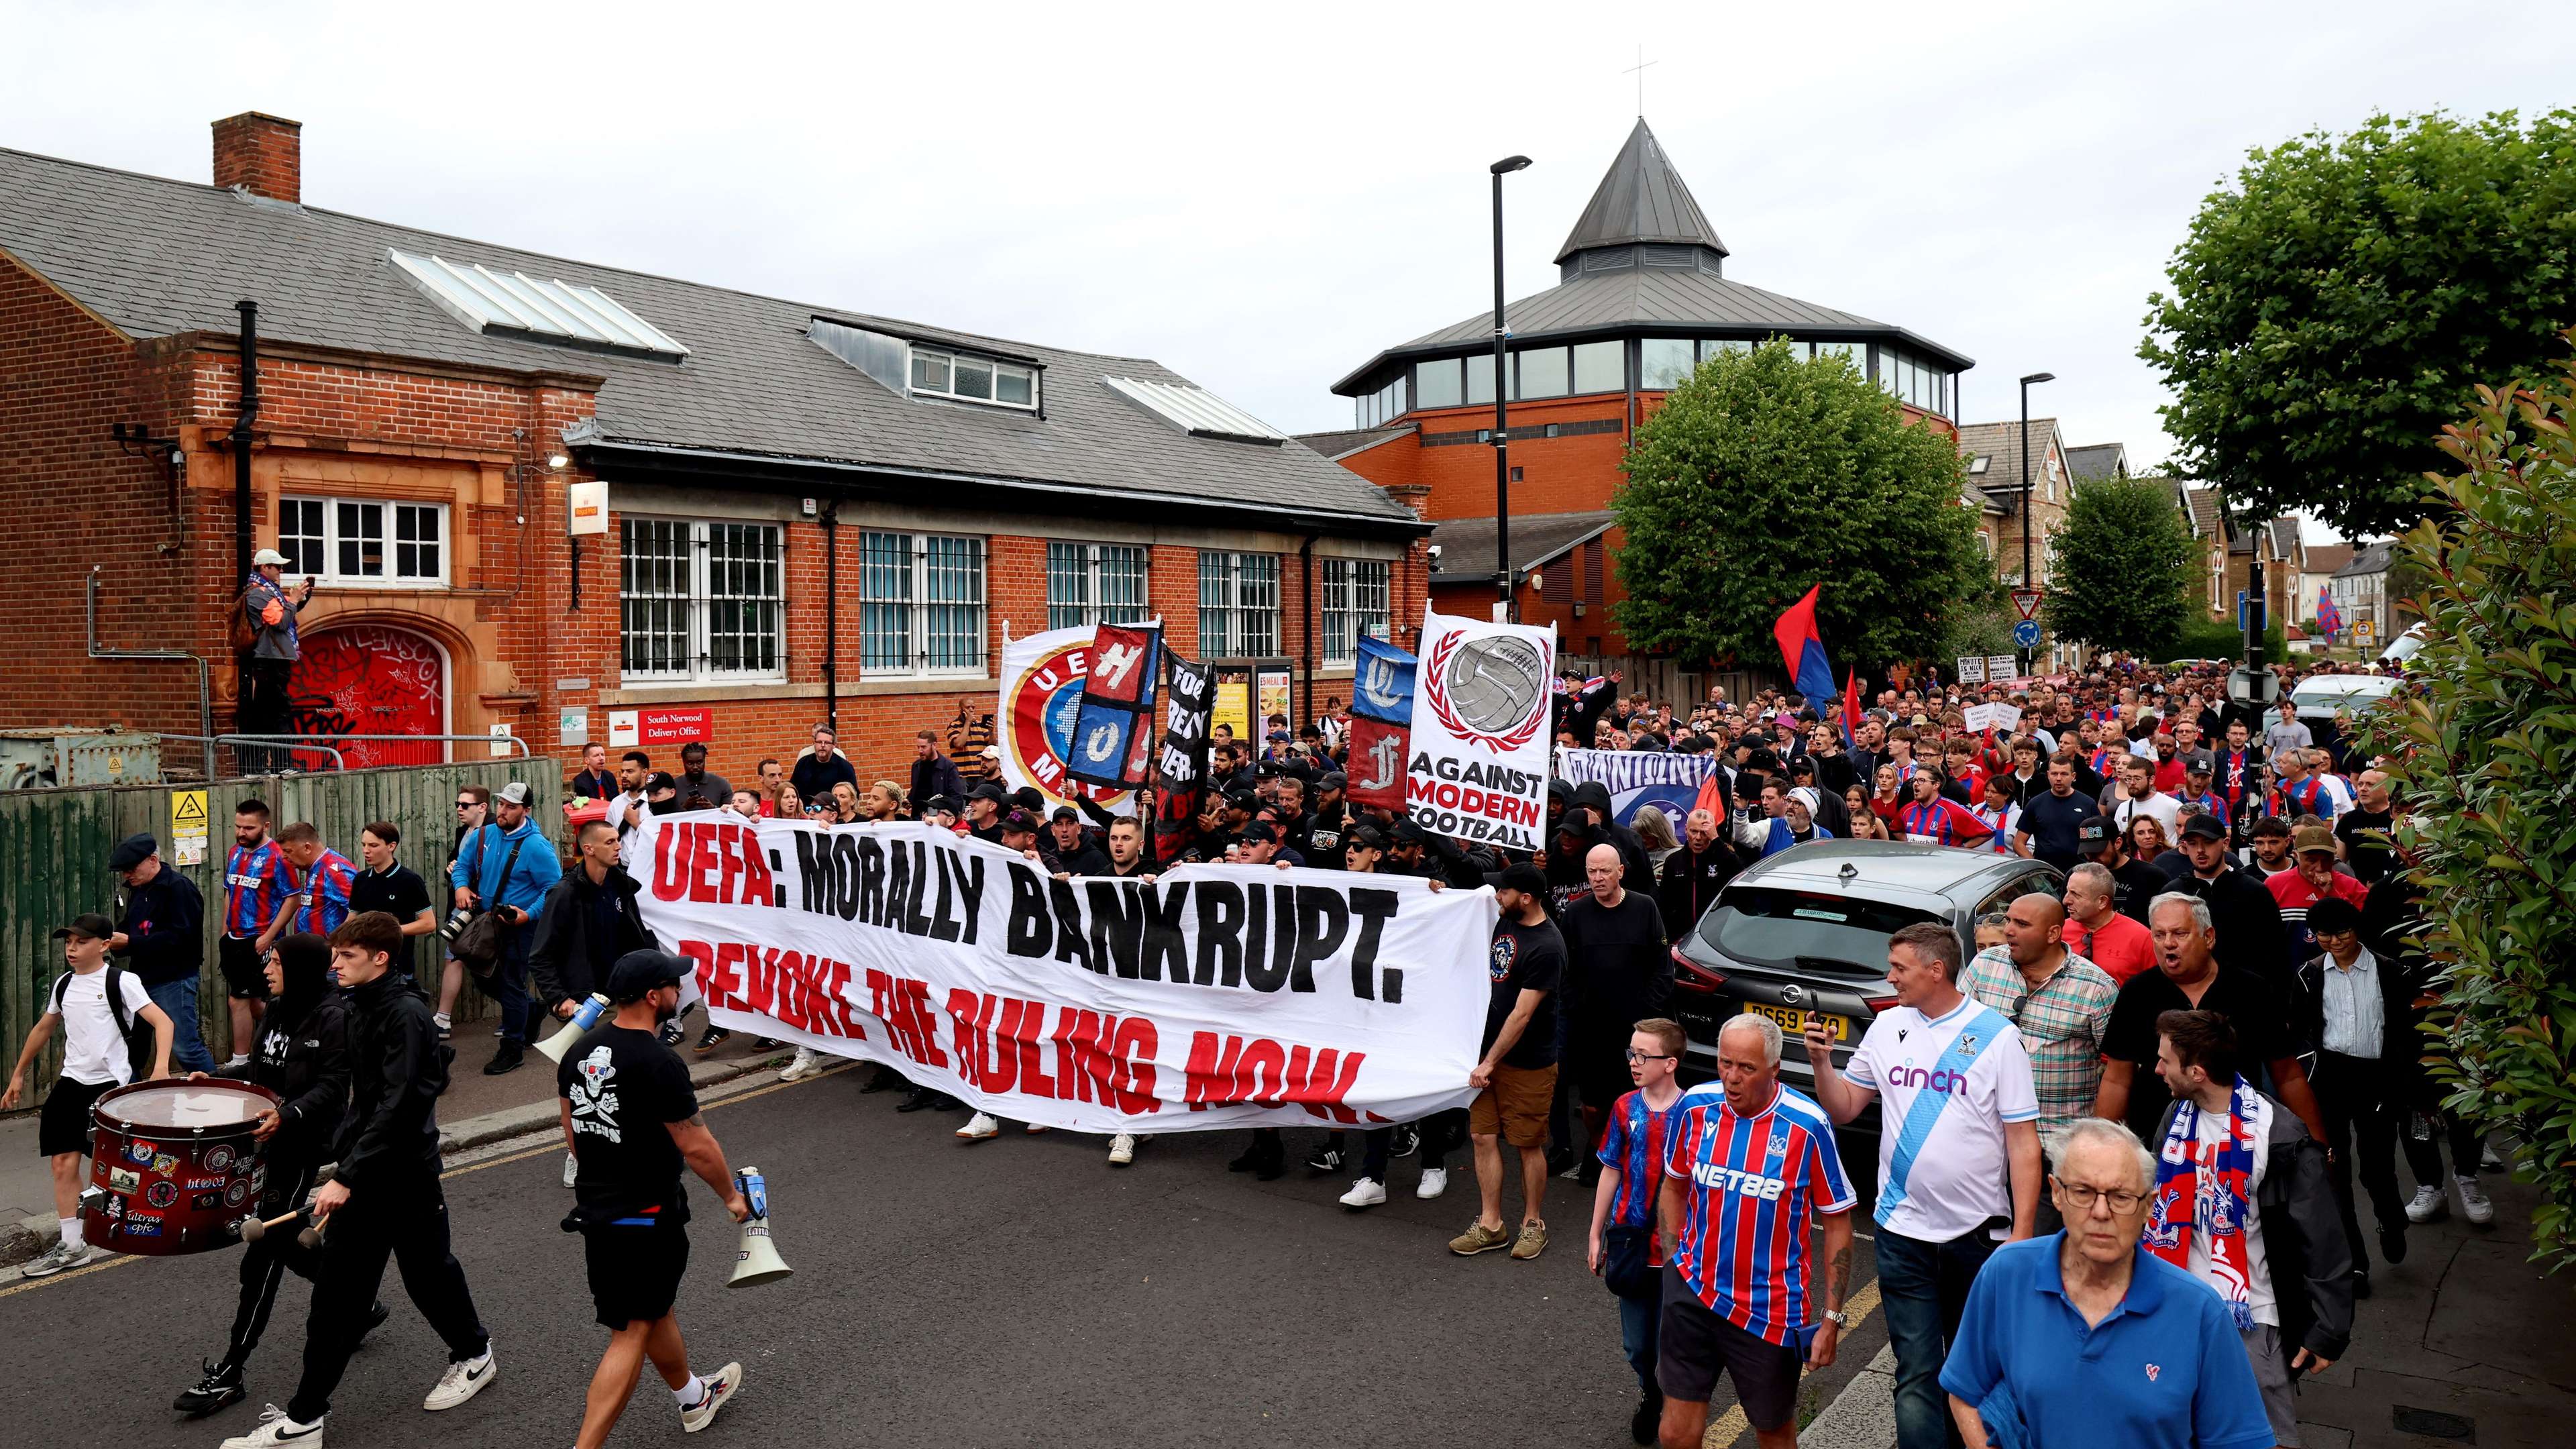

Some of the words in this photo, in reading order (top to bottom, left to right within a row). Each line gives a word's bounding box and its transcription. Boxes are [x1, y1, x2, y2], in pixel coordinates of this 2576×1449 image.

[1032, 651, 1088, 691] UE
[1267, 676, 1279, 686] MEAL
[647, 714, 668, 724] South
[670, 712, 702, 723] Norwood
[648, 728, 678, 739] Delivery
[679, 727, 700, 736] Office
[1258, 765, 1265, 773] LA
[1408, 751, 1542, 799] AGAINST
[1406, 775, 1540, 828] MODERN
[1406, 803, 1538, 851] FOOTBALL
[2079, 826, 2103, 839] 1983
[652, 822, 787, 908] UEFA:
[794, 829, 984, 945] MORALLY
[1006, 861, 1404, 1004] BANKRUPT.
[678, 940, 867, 1041] REVOKE
[866, 968, 949, 1069] THE
[945, 987, 1163, 1115] RULING
[1888, 1058, 1967, 1095] cinch
[571, 1118, 621, 1144] ULTRAS
[1691, 1161, 1787, 1201] NET88
[127, 1212, 162, 1223] ultras
[131, 1222, 155, 1235] cpfc
